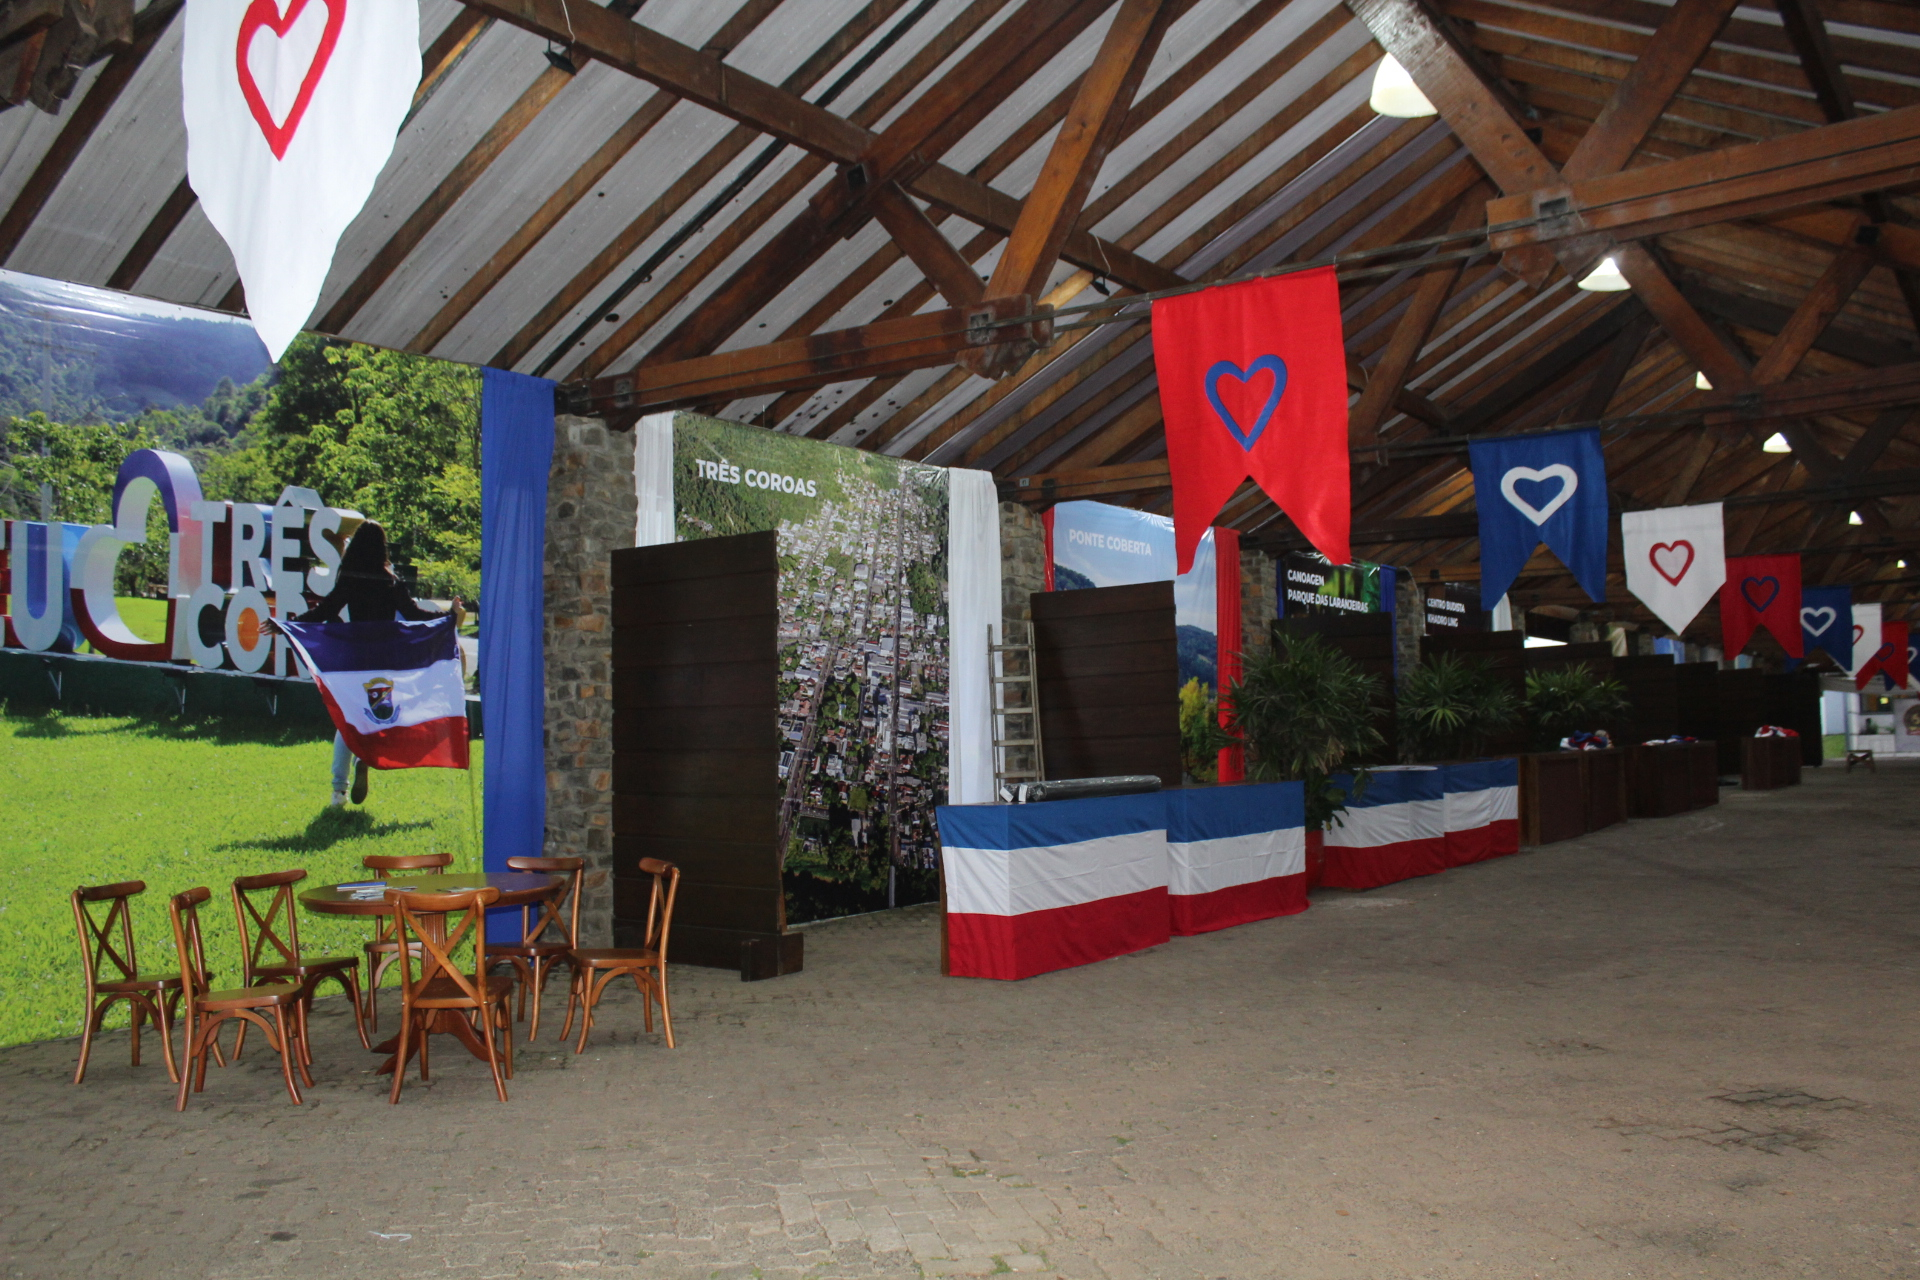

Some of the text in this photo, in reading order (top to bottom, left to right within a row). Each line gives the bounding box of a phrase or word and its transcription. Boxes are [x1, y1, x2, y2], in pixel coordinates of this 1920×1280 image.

[695, 459, 817, 497] TRÊS COROAS
[1069, 529, 1152, 556] PONTE COBERTA
[0, 519, 63, 651] U
[1287, 569, 1325, 586] CANOAGEM
[1287, 588, 1315, 605] PARQUE
[1315, 594, 1328, 606] DAS
